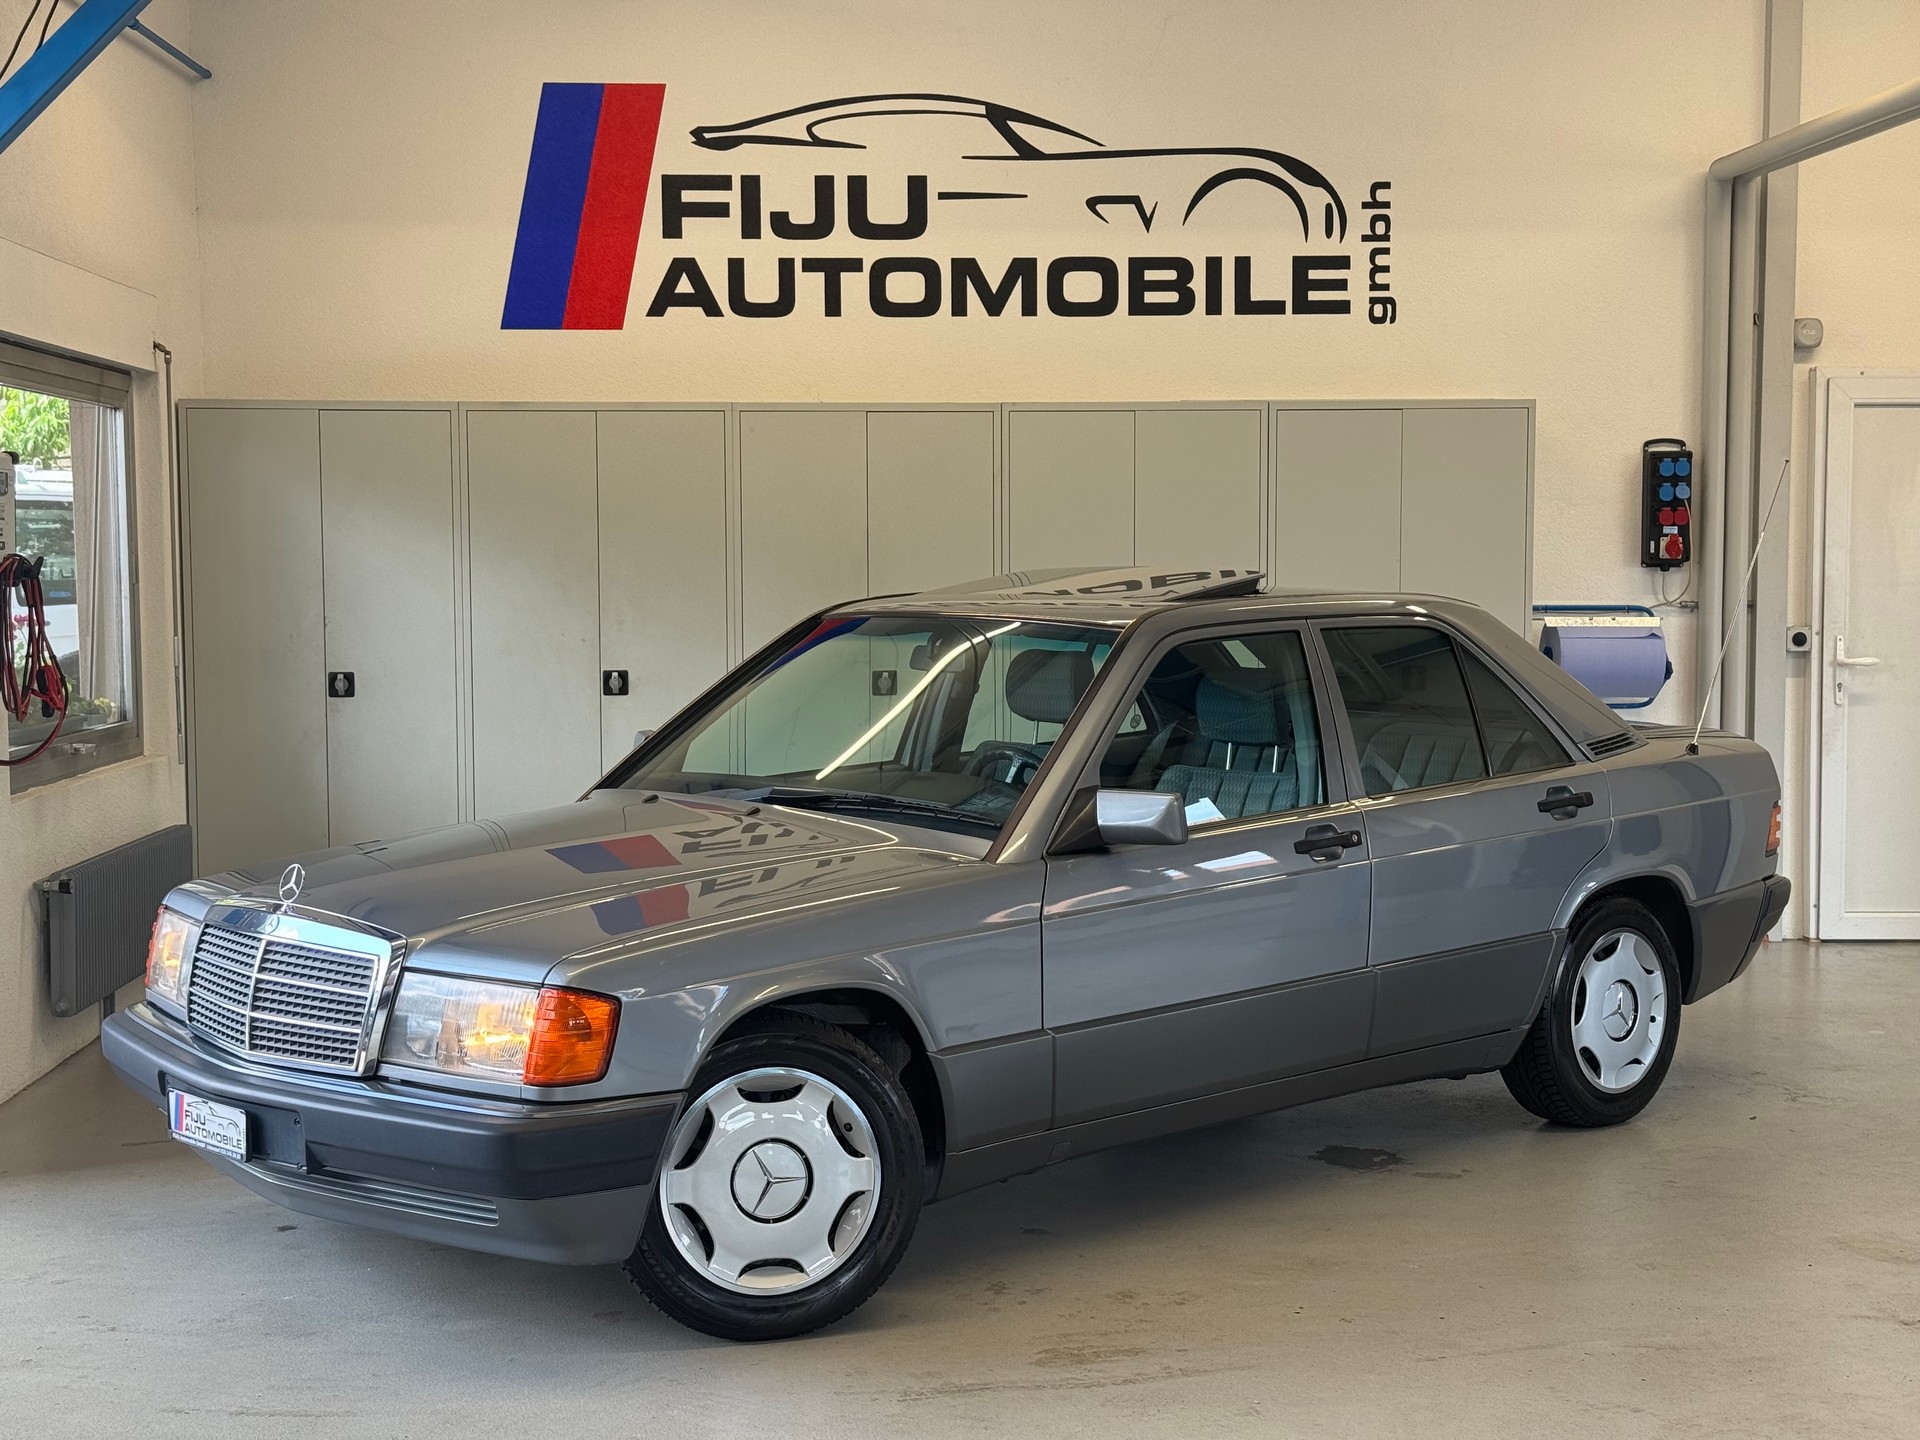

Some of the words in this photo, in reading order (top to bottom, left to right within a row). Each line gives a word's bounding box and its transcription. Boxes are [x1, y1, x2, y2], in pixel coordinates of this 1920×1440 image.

[661, 174, 928, 240] FIJU
[1361, 181, 1396, 325] gmbh
[645, 256, 1352, 318] AUTOMOBILE
[184, 1123, 242, 1149] AUTOMOBILE
[185, 1109, 206, 1125] FIJU
